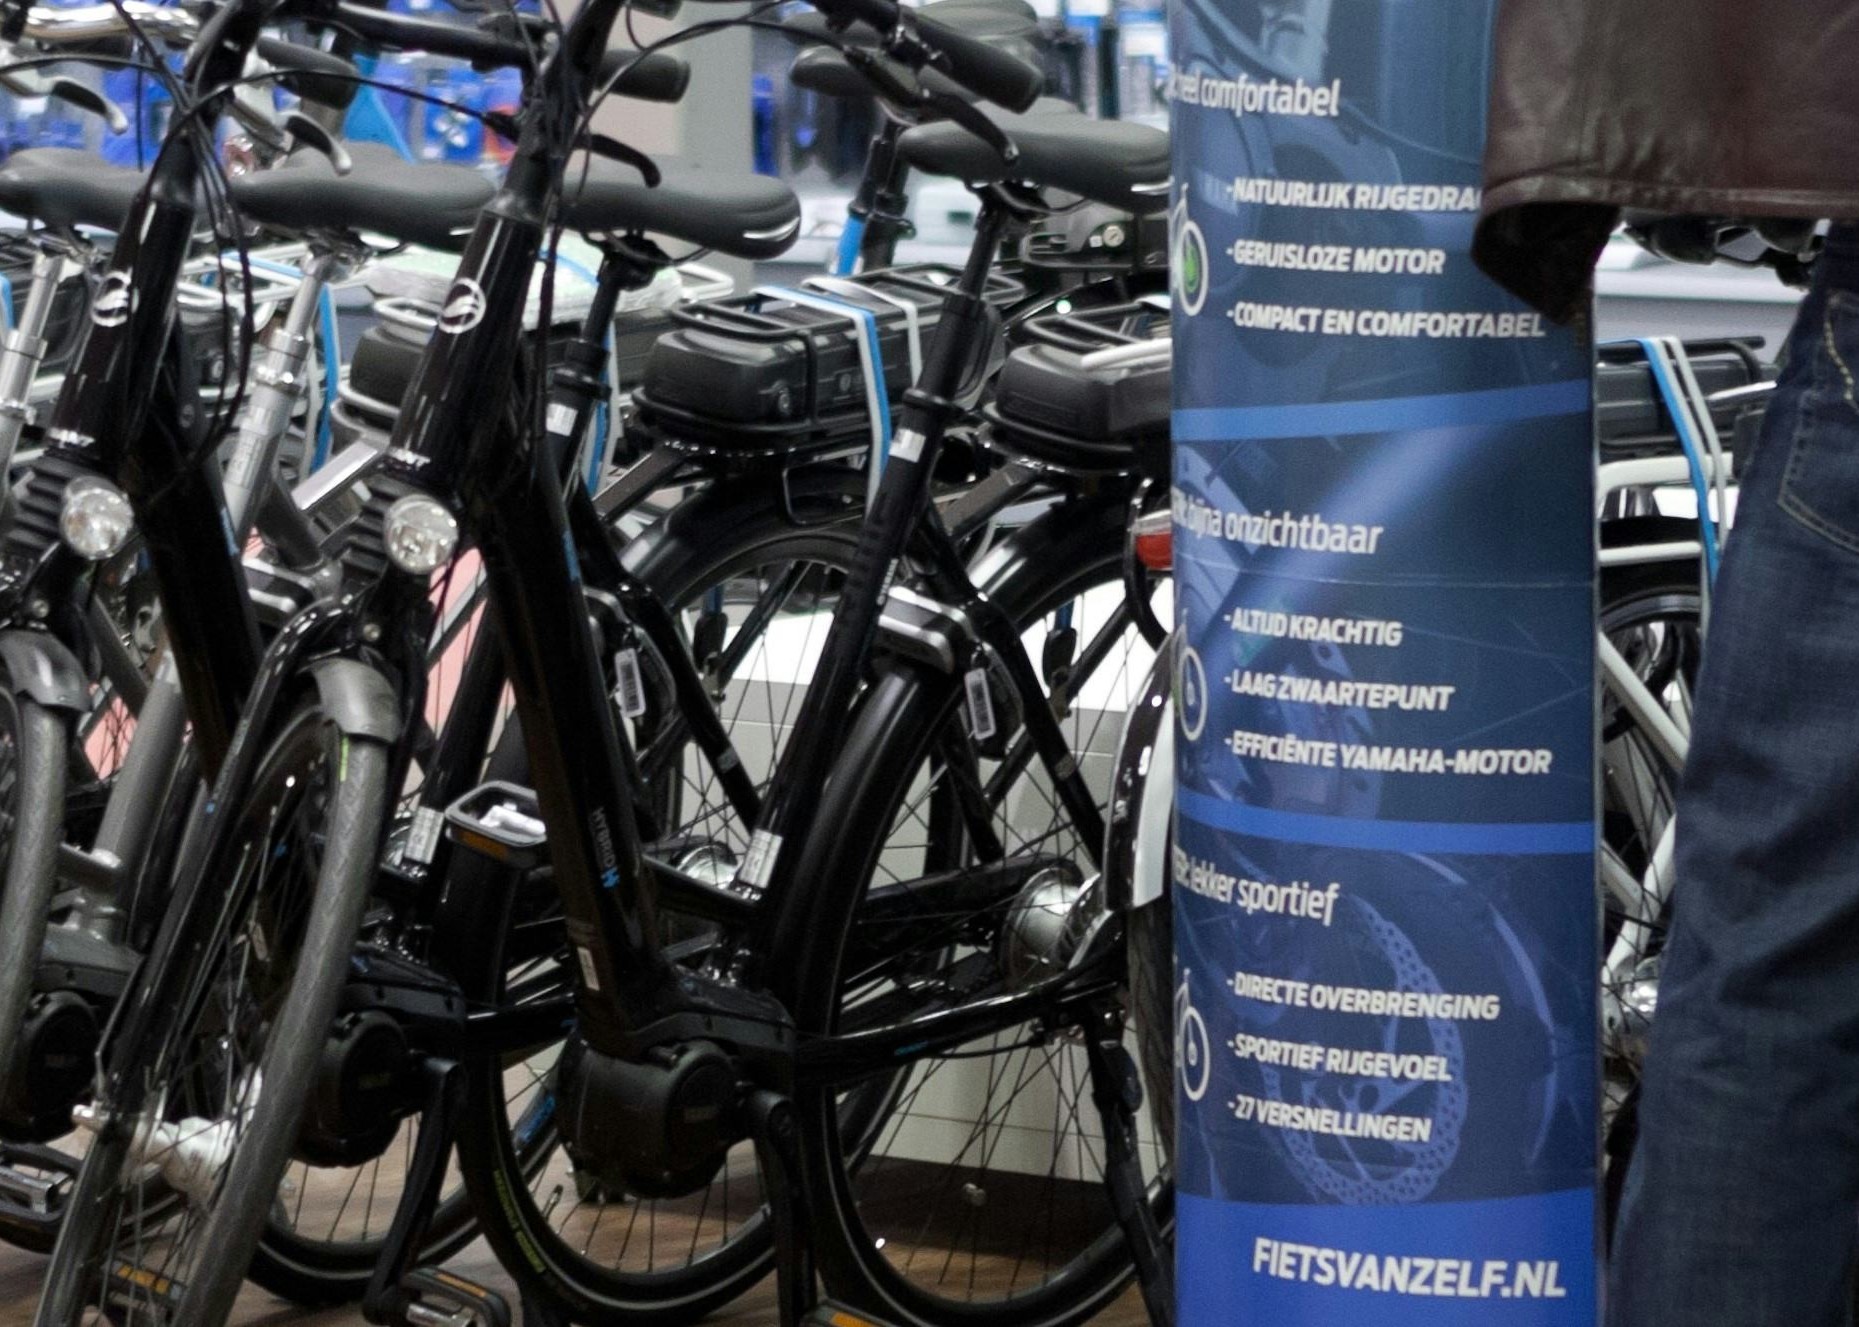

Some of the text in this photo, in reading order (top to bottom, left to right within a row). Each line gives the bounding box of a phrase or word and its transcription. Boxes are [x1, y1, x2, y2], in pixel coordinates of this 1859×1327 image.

[1200, 72, 1341, 117] comfortabel
[1354, 183, 1483, 212] RIJGEDRA
[1355, 248, 1446, 275] MOTOR
[1322, 309, 1354, 335] EN
[1356, 310, 1546, 338] COMFORTABEL
[1225, 510, 1384, 554] onzichtbaar
[1288, 615, 1403, 646] KRACHTIG
[1277, 673, 1455, 711] ZWAARTEPUNT
[1339, 743, 1553, 775] YAMAHA-MOTOR
[1237, 880, 1340, 926] sportief
[1310, 985, 1500, 1020] OVERBRENGING
[1326, 1049, 1453, 1082] RIJGEVOEL
[1255, 1099, 1433, 1143] VERSNELLINGEN
[1253, 1236, 1567, 1299] FIETSVANZELF.NL
